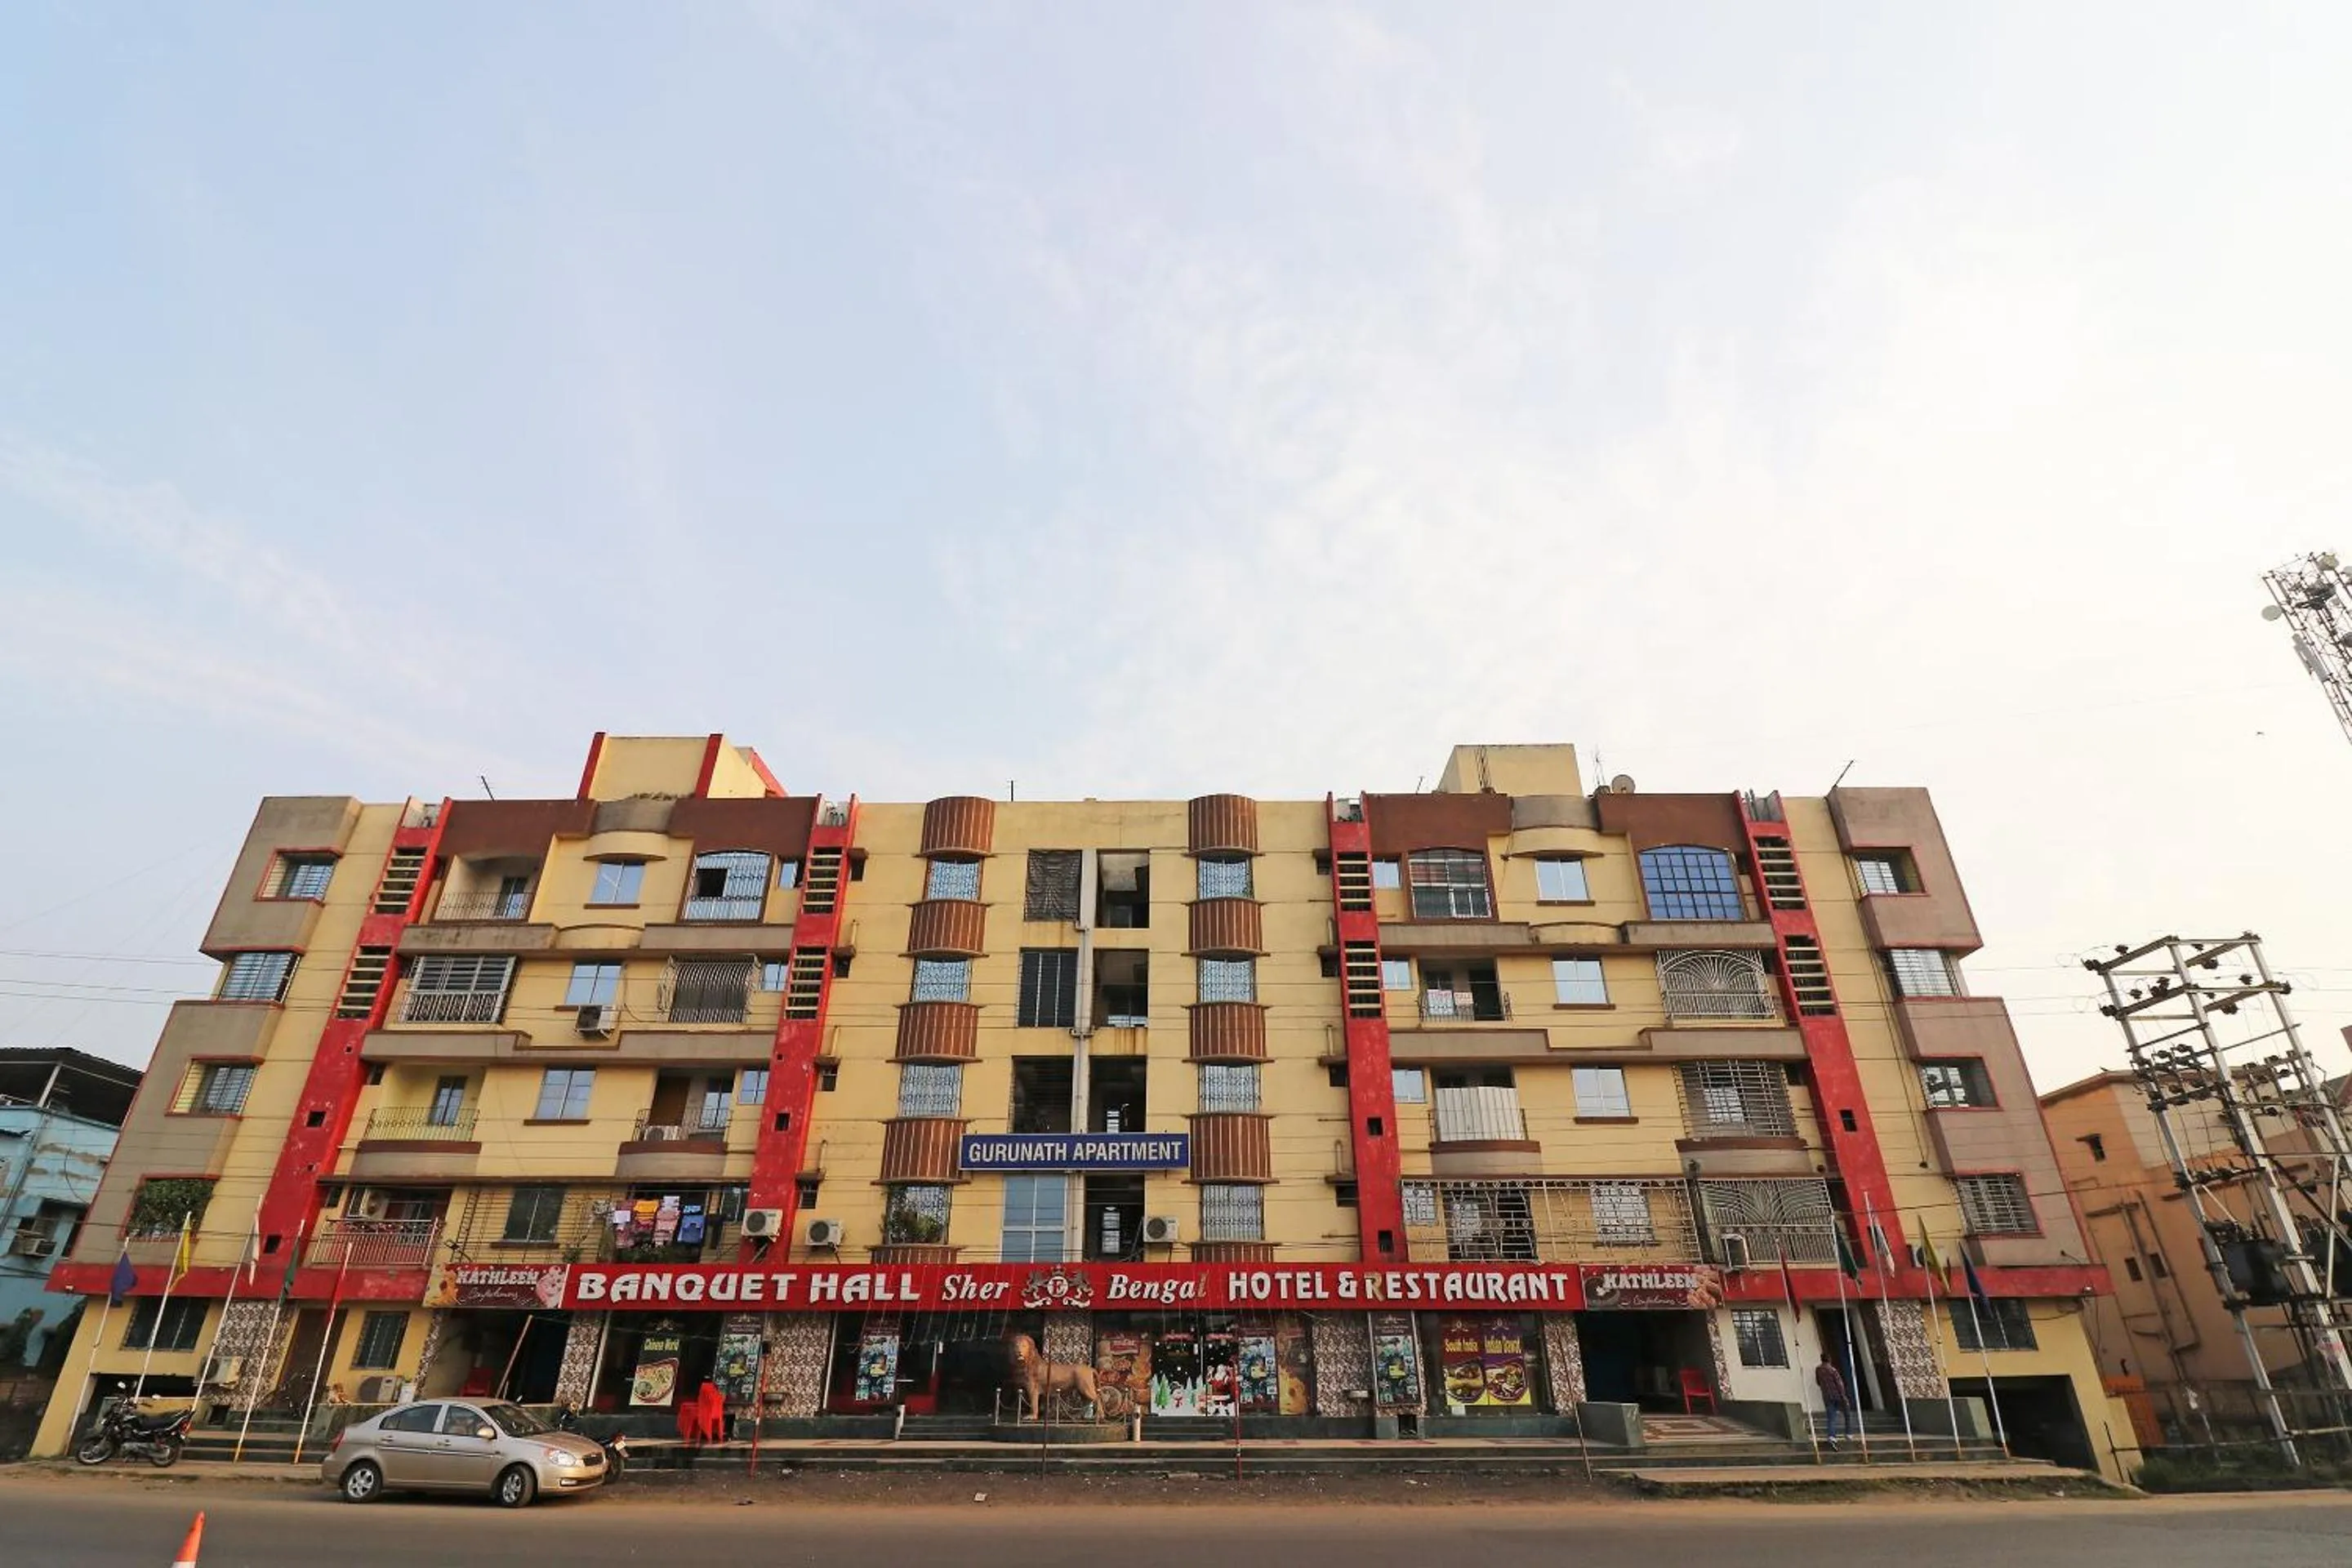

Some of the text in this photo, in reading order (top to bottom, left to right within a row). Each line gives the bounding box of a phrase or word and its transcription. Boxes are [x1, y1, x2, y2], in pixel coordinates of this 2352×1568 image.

[969, 1142, 1182, 1162] GURUNATH APARTMENT
[457, 1272, 538, 1285] KATHLEEN
[577, 1273, 920, 1303] BANQUET HALL
[942, 1270, 1209, 1303] Sher Bengal
[1229, 1272, 1567, 1303] HOTEL & RESTAURANT
[1603, 1273, 1698, 1289] KATHLEEN
